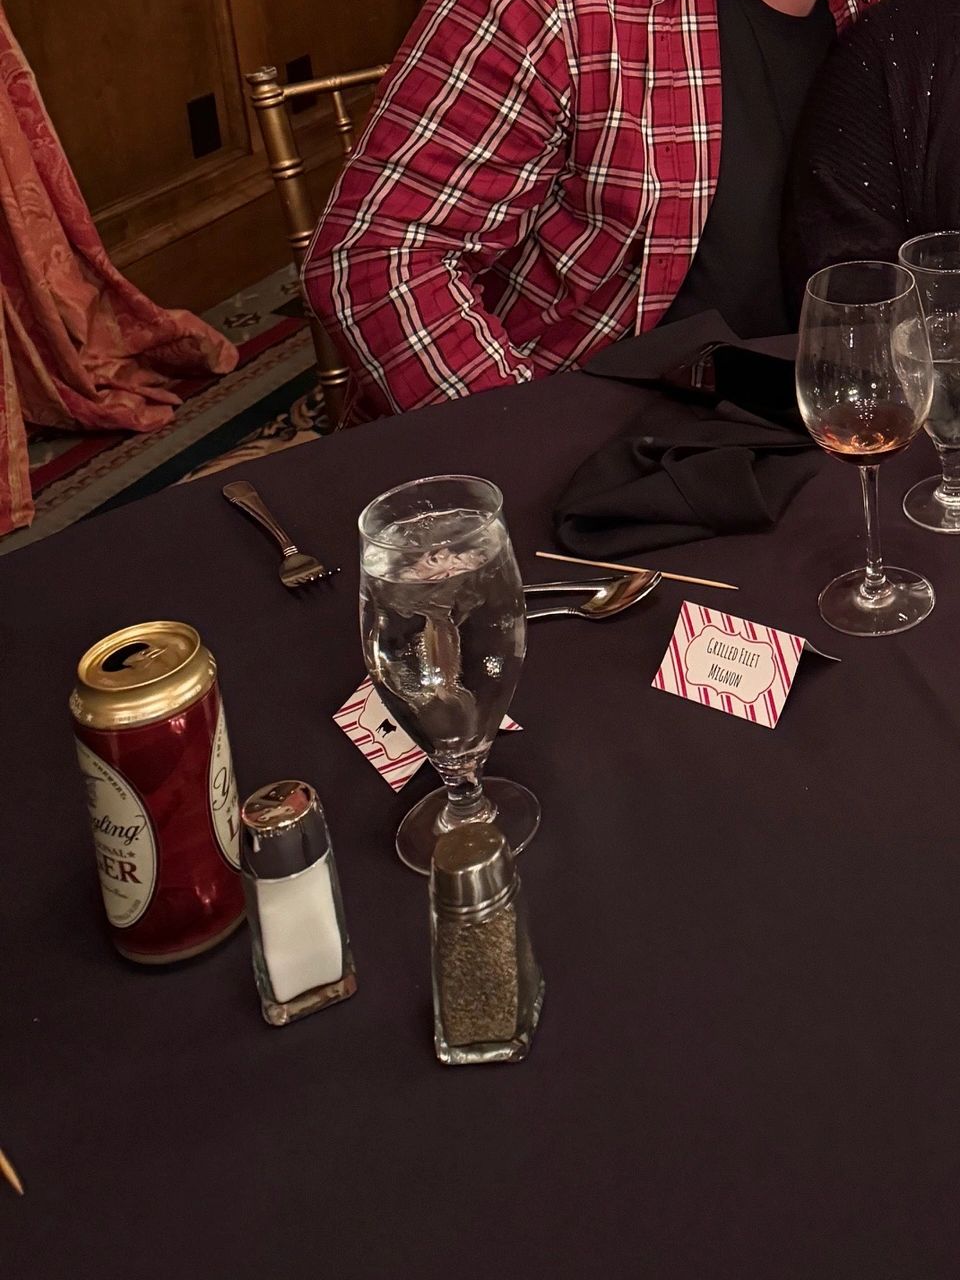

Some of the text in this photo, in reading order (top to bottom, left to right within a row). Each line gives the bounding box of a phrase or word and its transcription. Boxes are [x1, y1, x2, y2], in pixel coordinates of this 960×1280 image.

[706, 637, 761, 669] GRILLED FILET
[708, 663, 743, 688] MIGNON
